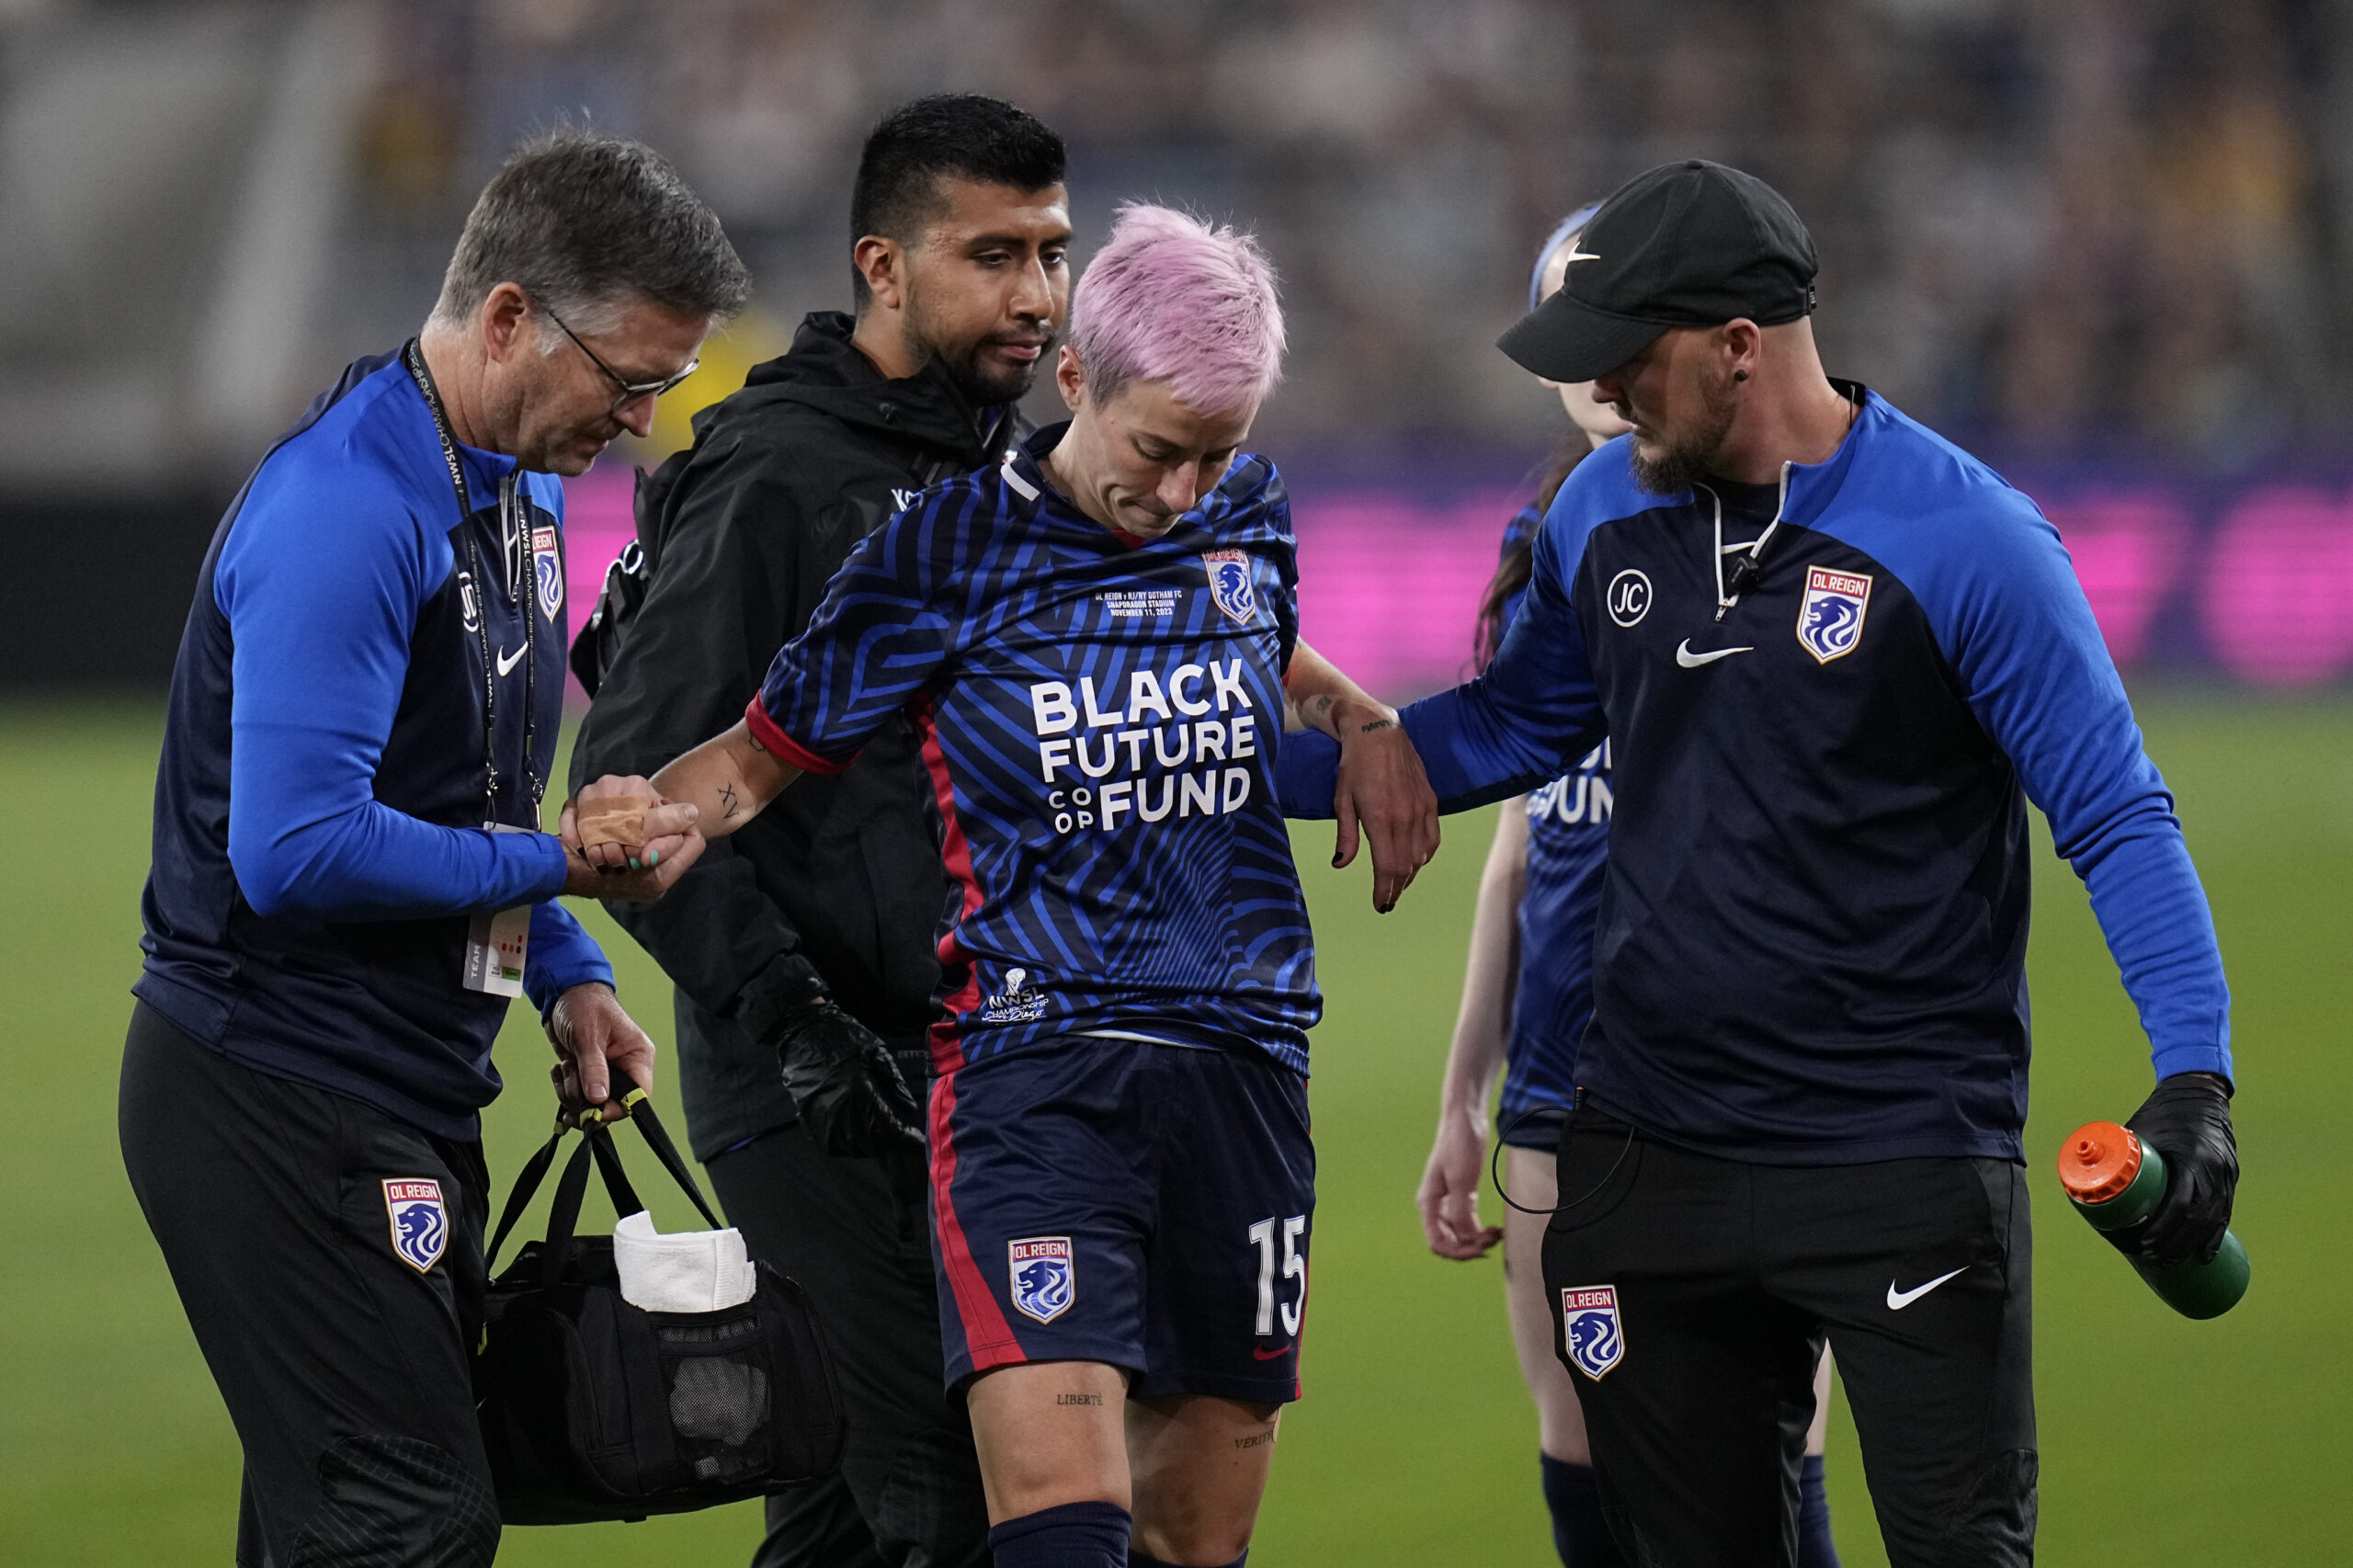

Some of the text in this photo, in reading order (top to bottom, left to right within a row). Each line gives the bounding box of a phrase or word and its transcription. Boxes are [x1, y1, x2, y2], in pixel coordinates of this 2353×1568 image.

[413, 369, 450, 447] CHAMPIONSHIP
[444, 447, 462, 484] NWSL
[519, 519, 530, 557] NWSL
[1095, 592, 1103, 600] OL
[1104, 592, 1122, 600] REIGN
[1128, 591, 1147, 600] NJ/NY
[1148, 590, 1173, 599] GOTHAM
[1174, 590, 1182, 598] FC
[1614, 583, 1643, 613] JC
[1813, 573, 1865, 596] OL REIGN
[1107, 599, 1176, 608] SNAPDRAGON STADIUM
[1109, 608, 1143, 617] NOVEMBER
[1156, 608, 1173, 616] 2023
[1029, 658, 1253, 735] BLACK
[1039, 715, 1256, 783] FUTURE
[1100, 767, 1251, 831] FUND
[1054, 810, 1094, 834] OP
[471, 945, 481, 978] TEAM
[989, 987, 1045, 1009] NWSL
[390, 1184, 438, 1199] OL REIGN
[1015, 1243, 1066, 1259] OL REIGN
[1249, 1214, 1305, 1335] 15
[1566, 1291, 1611, 1309] OL REIGN
